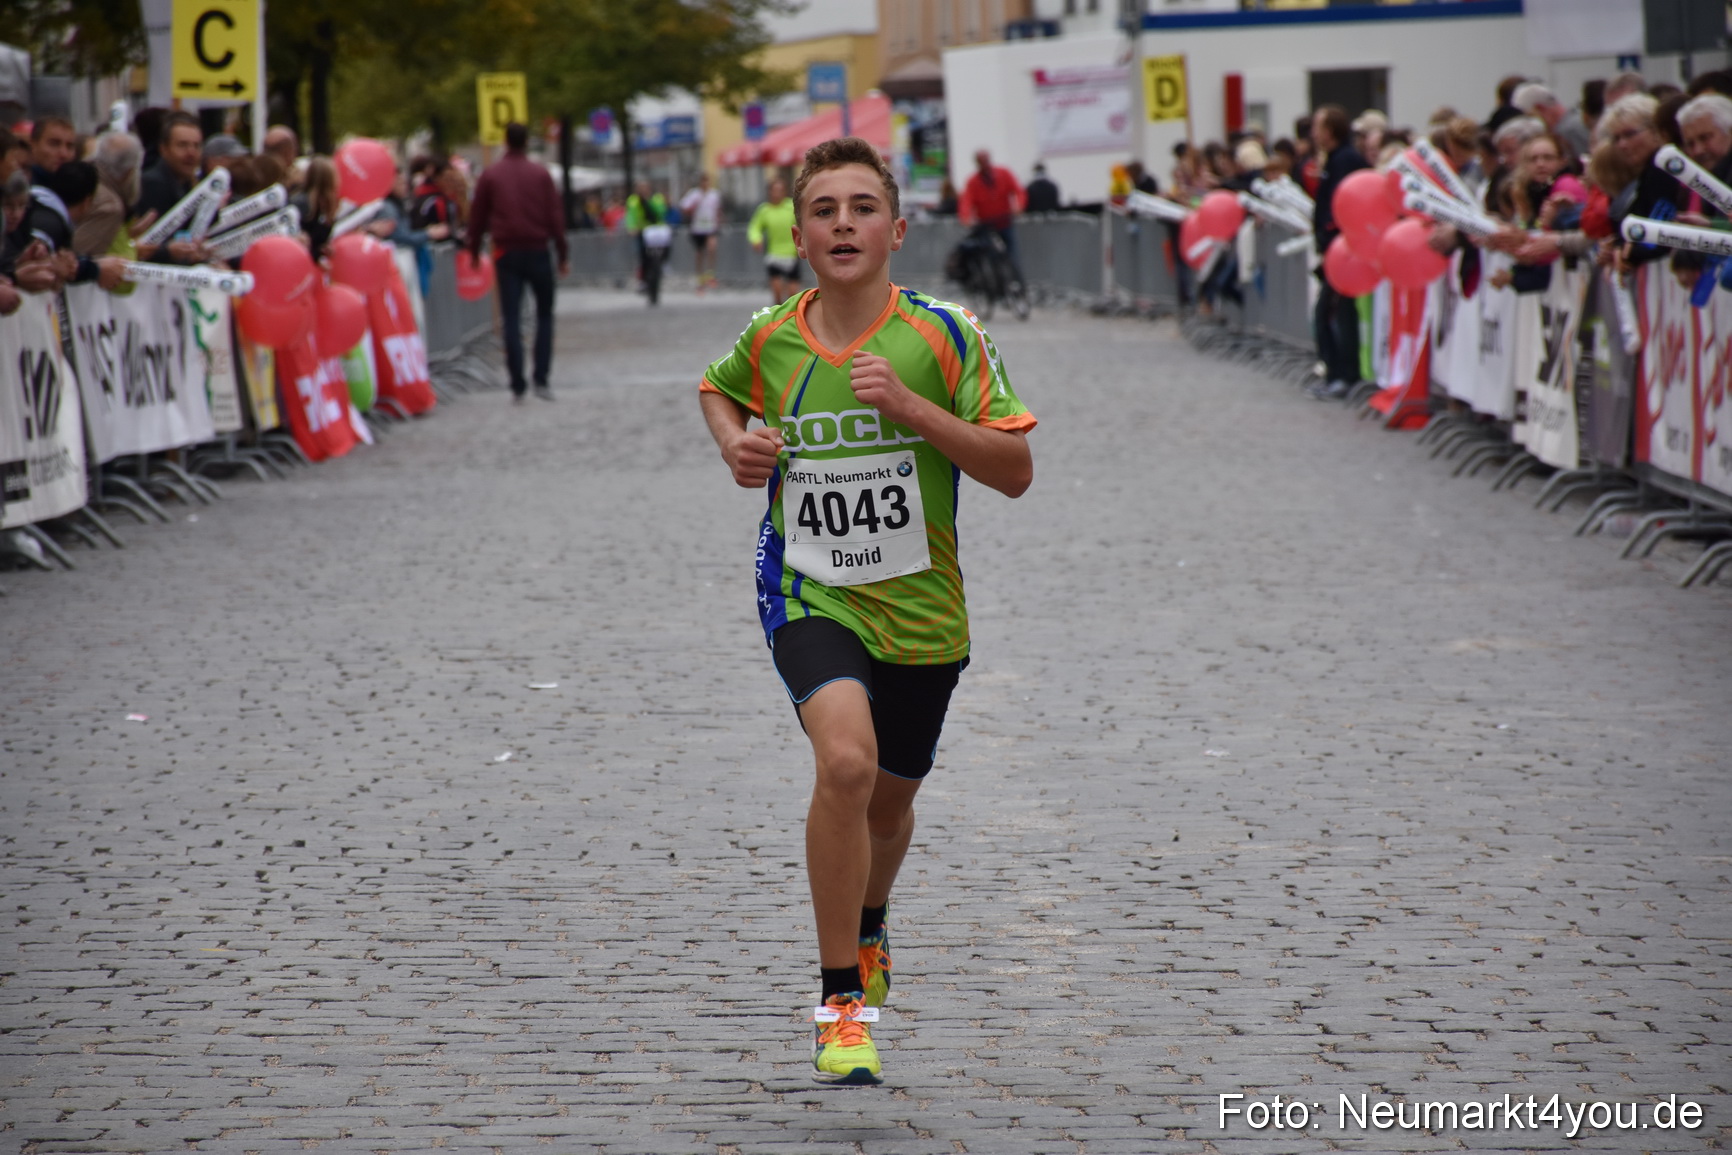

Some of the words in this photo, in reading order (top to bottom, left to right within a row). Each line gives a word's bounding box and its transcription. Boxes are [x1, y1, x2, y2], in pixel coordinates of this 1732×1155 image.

[193, 8, 237, 71] C
[1154, 74, 1180, 108] D
[786, 471, 822, 485] PARTL
[825, 468, 892, 485] Neumarkt
[798, 485, 910, 538] 4043
[832, 546, 882, 568] David
